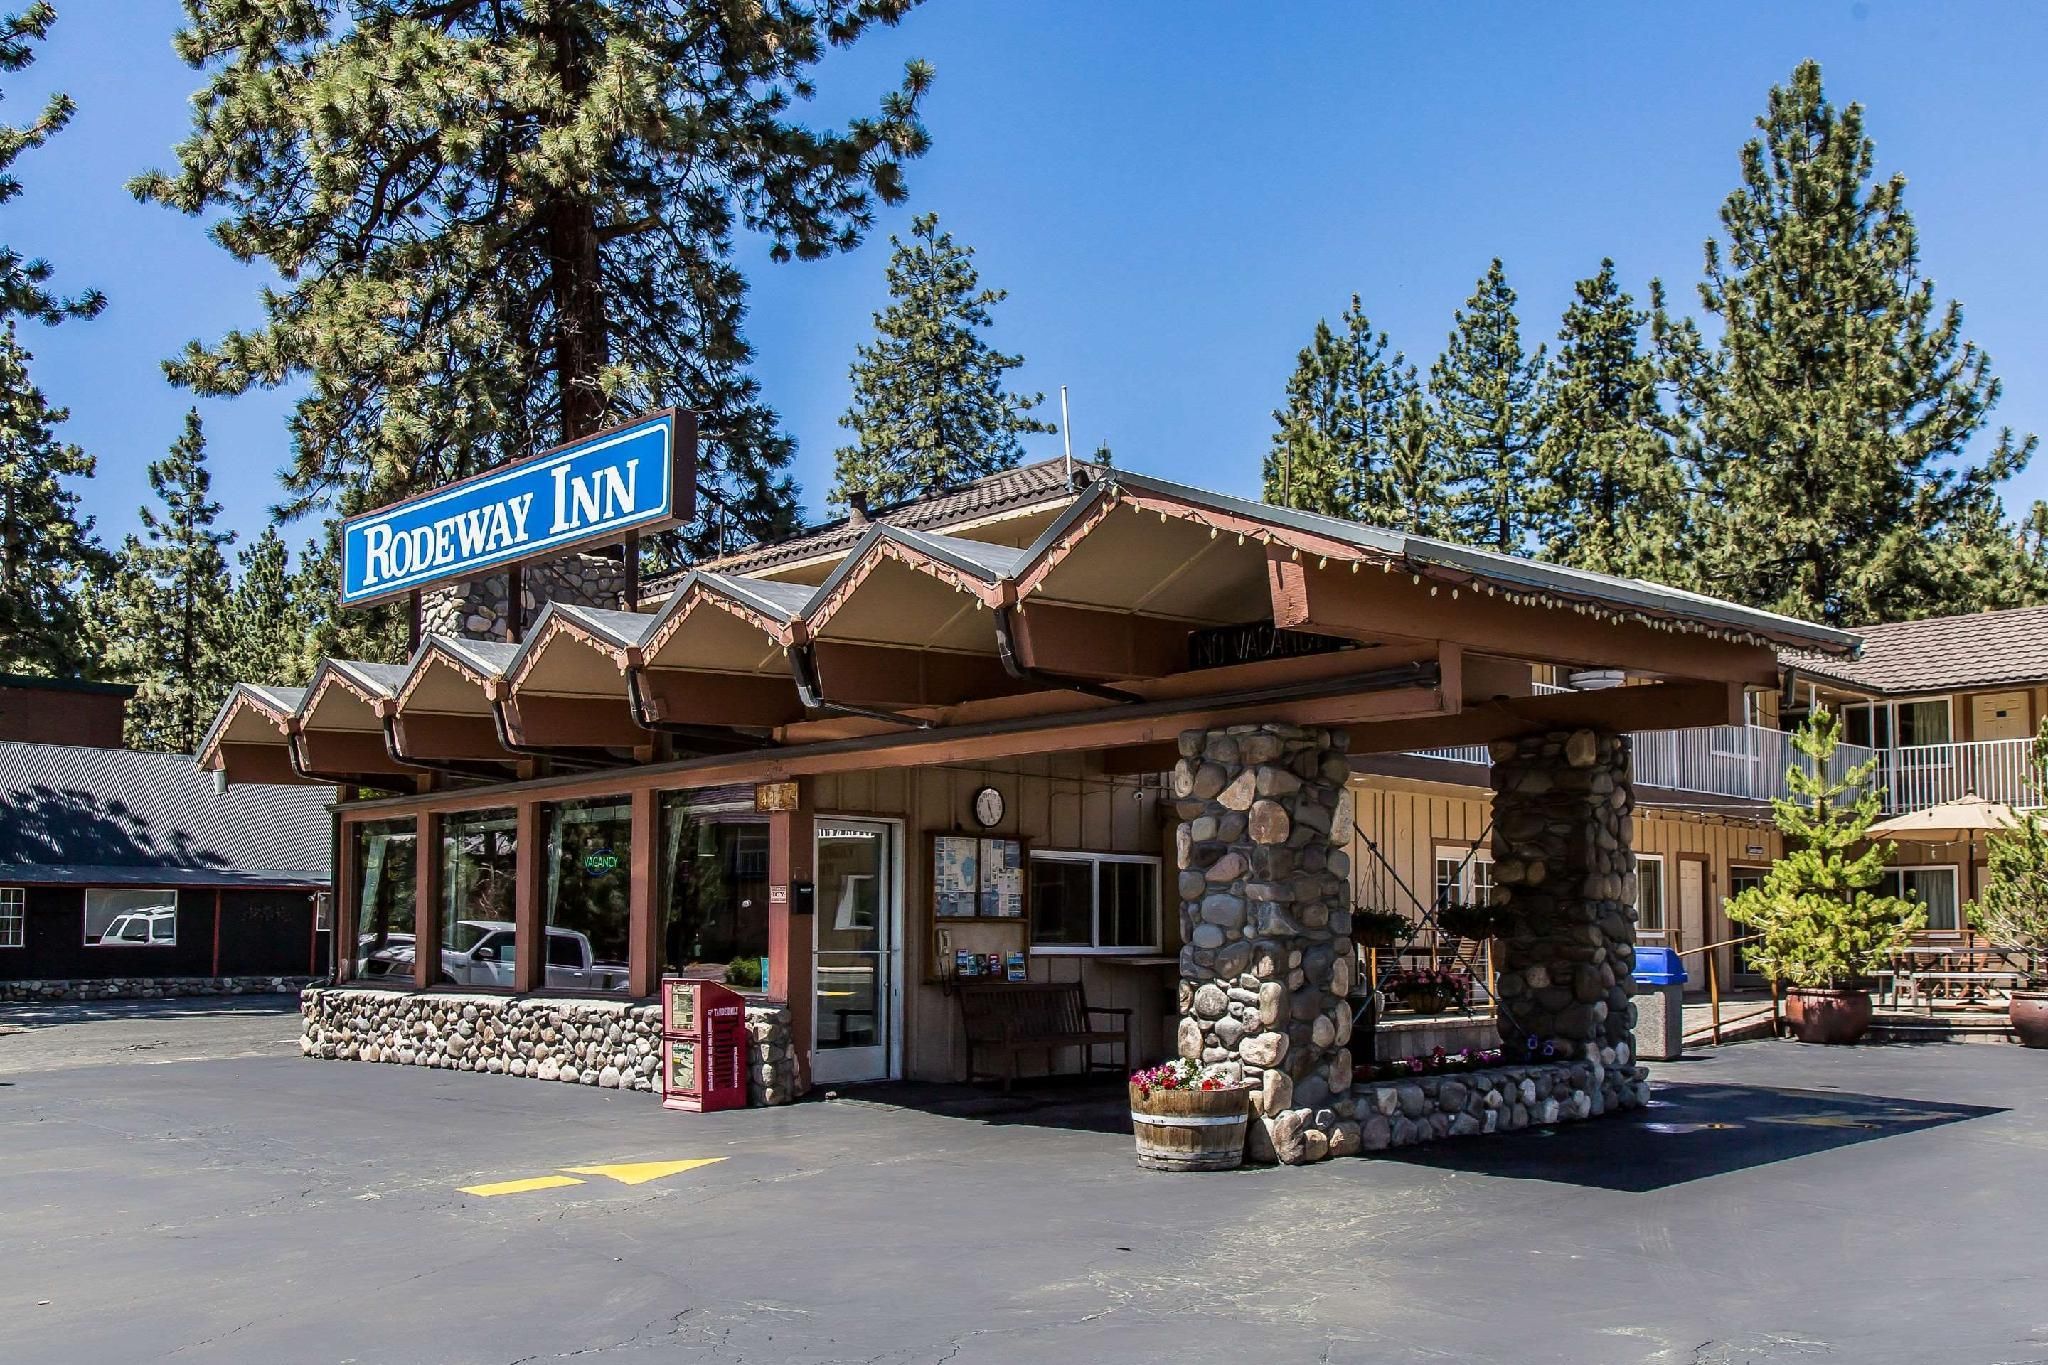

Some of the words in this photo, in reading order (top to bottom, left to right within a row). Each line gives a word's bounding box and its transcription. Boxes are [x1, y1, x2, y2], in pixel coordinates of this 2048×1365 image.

[363, 492, 534, 586] RODEWAY
[549, 459, 639, 534] INN
[584, 856, 618, 868] VACANCY
